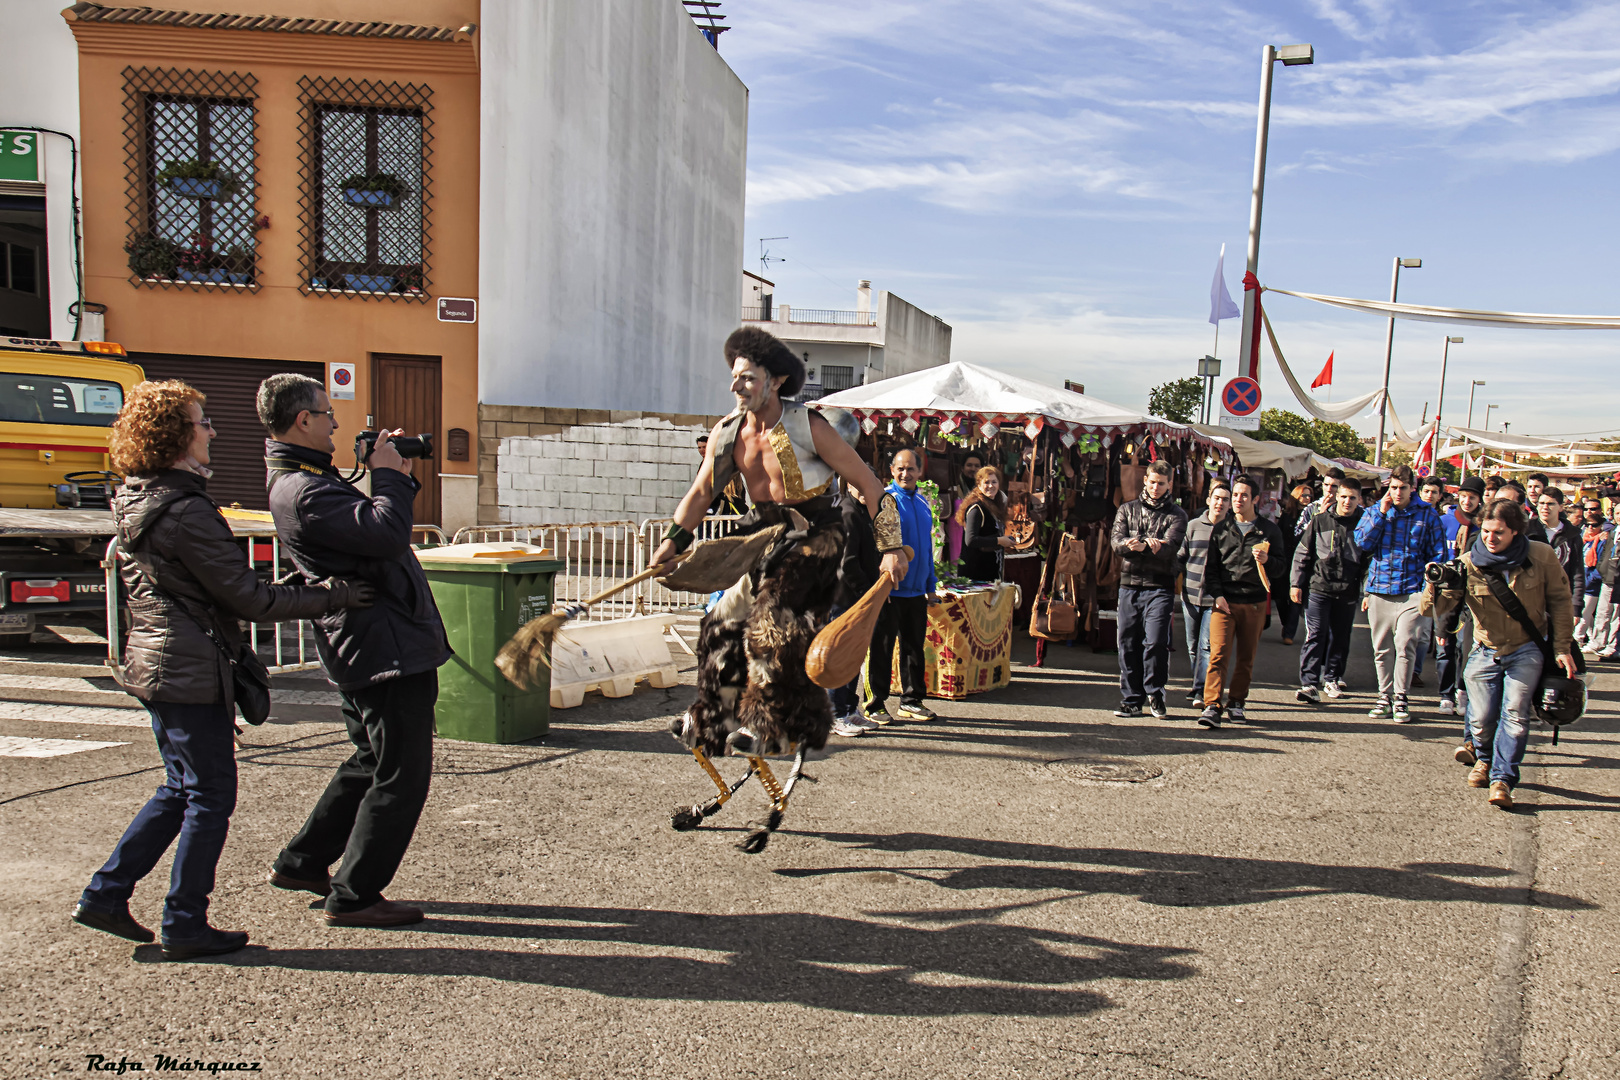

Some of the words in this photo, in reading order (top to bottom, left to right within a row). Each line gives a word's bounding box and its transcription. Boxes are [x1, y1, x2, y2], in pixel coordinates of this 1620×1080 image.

[0, 134, 33, 155] S
[445, 309, 468, 317] Segunda
[8, 338, 62, 348] GRUA
[75, 584, 106, 593] IVEC
